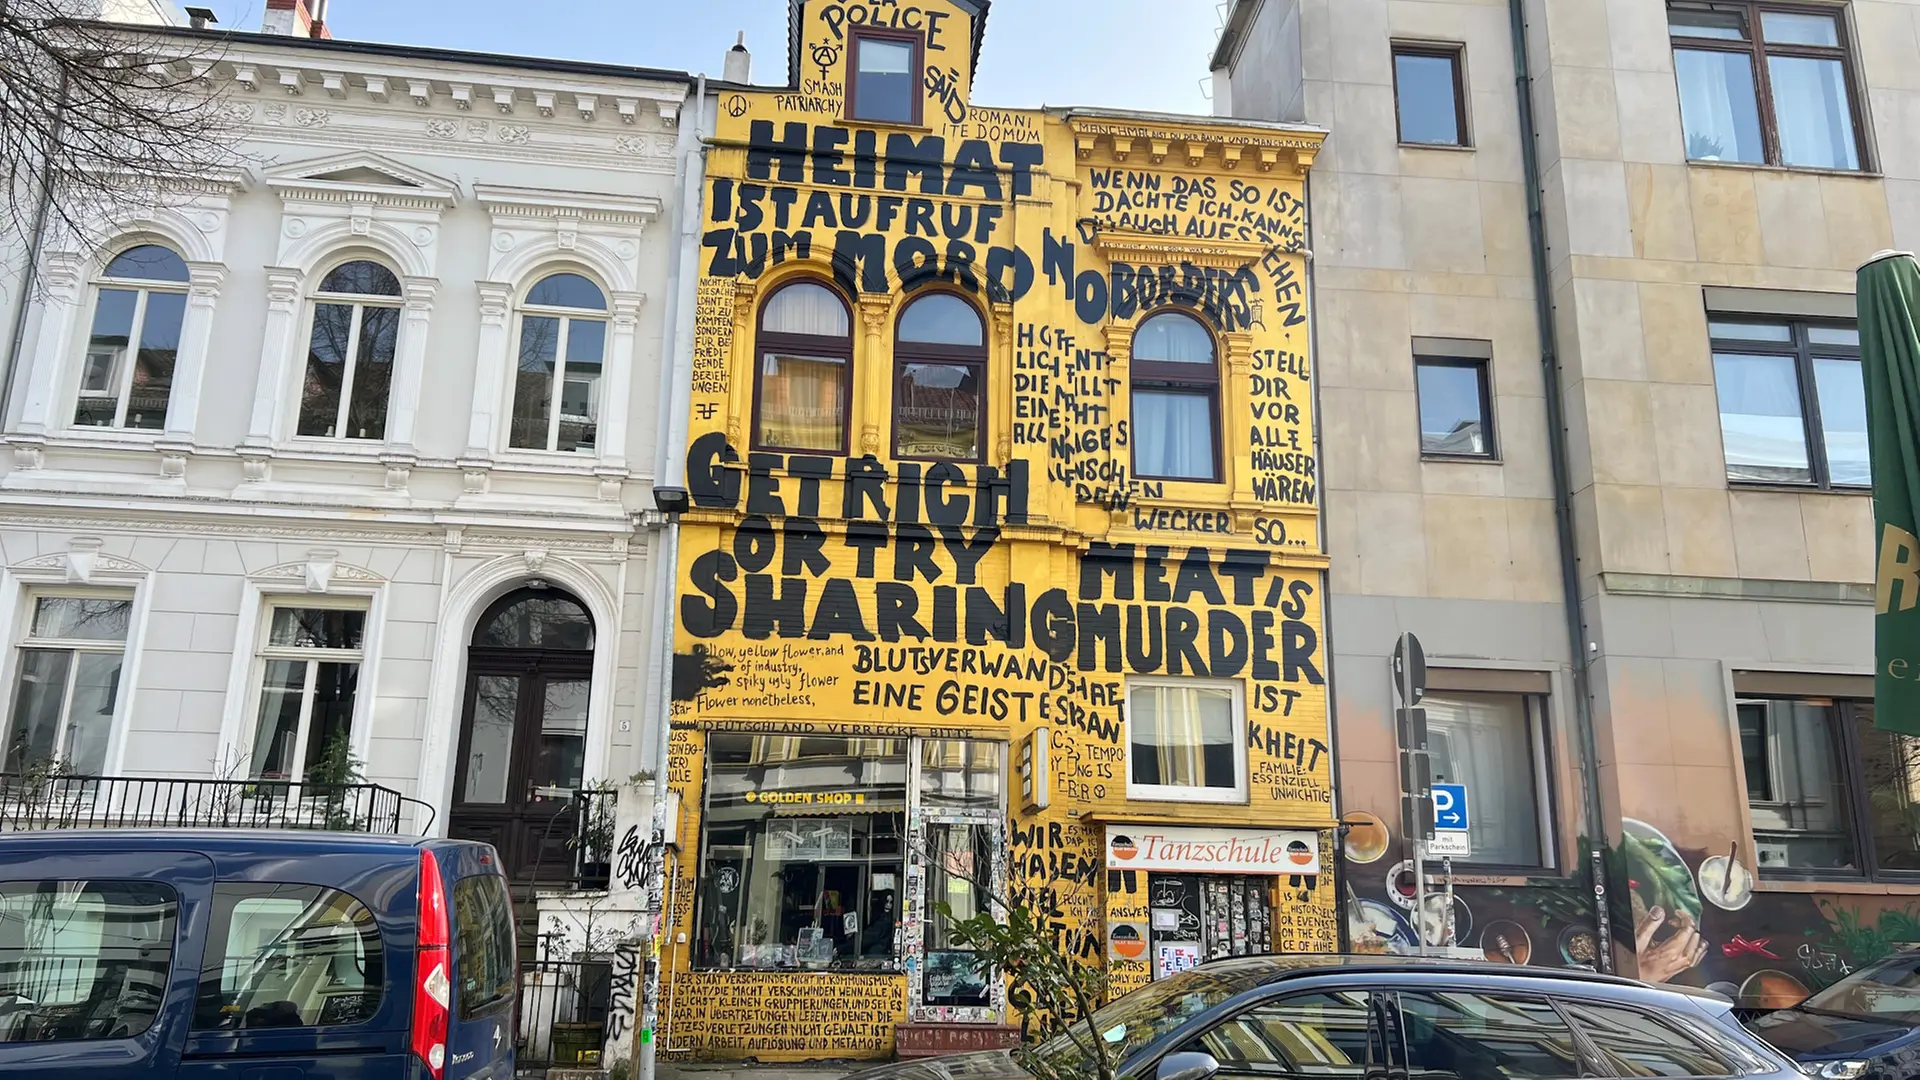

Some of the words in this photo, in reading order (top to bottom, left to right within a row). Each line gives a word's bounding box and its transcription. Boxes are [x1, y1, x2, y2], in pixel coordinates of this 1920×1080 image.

[820, 5, 950, 51] POLICE
[804, 78, 842, 97] SMASH
[774, 95, 843, 117] PATRIARCHY
[969, 109, 1031, 128] ROMANI
[943, 123, 969, 138] ITE
[975, 124, 1040, 142] DOMUM
[747, 120, 1044, 200] HEIMAT
[1090, 167, 1161, 191] WENN
[1171, 176, 1216, 199] DAS
[1230, 179, 1261, 204] SO
[711, 179, 798, 232] IST
[801, 190, 1003, 244] AUFRUF
[1092, 190, 1189, 213] DACHTE
[1119, 212, 1179, 235] AUCH
[702, 228, 811, 280] ZUM
[831, 230, 1035, 304] MORD
[1042, 227, 1107, 325] NO
[1110, 261, 1260, 332] BORDERS
[697, 287, 711, 296] DIE
[710, 287, 735, 297] SACHE
[695, 306, 715, 316] SICH
[717, 307, 732, 317] ZU
[724, 298, 733, 307] ES
[693, 358, 724, 370] GENDE
[1251, 349, 1310, 381] STELL
[692, 370, 730, 382] BEZIEH-
[1249, 374, 1292, 400] DIR
[1250, 401, 1300, 425] VOR
[1250, 426, 1302, 450] ALLE
[1251, 448, 1316, 480] HÄUSER
[687, 431, 833, 517] GET
[842, 453, 1029, 525] RICH
[1251, 472, 1316, 504] WÄREN
[1134, 507, 1232, 536] WECKER
[733, 514, 831, 578] OR
[844, 520, 1001, 585] TRY
[1078, 541, 1272, 606] MEAT
[1264, 576, 1314, 620] IS
[681, 549, 1076, 662] SHARING
[703, 643, 737, 660] ellow,
[739, 644, 780, 661] yellow
[825, 644, 844, 656] and
[1077, 602, 1325, 685] MURDER
[741, 661, 752, 676] of
[755, 660, 802, 677] industry,
[736, 673, 766, 692] spiky
[768, 677, 791, 691] ugly
[798, 673, 839, 692] flower
[697, 692, 738, 713] Flower
[741, 693, 816, 708] nonetheless,
[1254, 684, 1302, 717] IST
[703, 719, 815, 734] DEUTSCHLAND
[827, 722, 917, 738] VERRECKE
[930, 727, 973, 739] BITTE
[853, 680, 925, 711] EINE
[1248, 720, 1329, 772] KHEIT
[670, 731, 688, 743] USS
[668, 769, 692, 783] ULLE
[1259, 761, 1307, 776] FAMILIE:
[1252, 772, 1320, 789] ESSENZIELL
[759, 791, 812, 805] GOLDEN
[816, 792, 852, 805] SHOP
[1270, 786, 1331, 803] UNWICHTIG
[1431, 789, 1454, 823] P
[1010, 818, 1064, 849] WIR
[1441, 835, 1454, 843] mit
[1142, 835, 1282, 865] Tanzschule
[1430, 842, 1467, 850] Parkschein
[1008, 850, 1098, 888] HABEN
[1110, 906, 1149, 918] ANSWER
[1281, 928, 1294, 938] ON
[1297, 928, 1314, 939] THE
[695, 973, 722, 985] STAAT
[724, 974, 790, 985] VERSCHWINDET
[732, 985, 763, 996] MACHT
[768, 985, 836, 996] VERSCHWINDEN
[839, 987, 864, 997] WENN
[719, 997, 760, 1007] KLEINEN
[890, 1000, 902, 1011] ES
[710, 1007, 795, 1021] ÜBERTRETUNGEN
[842, 1011, 873, 1021] DENEN
[877, 1011, 893, 1022] DIE
[791, 1024, 821, 1036] NICHT
[823, 1023, 868, 1036] GEWALT
[871, 1024, 889, 1037] IST
[809, 1038, 828, 1050] UND
